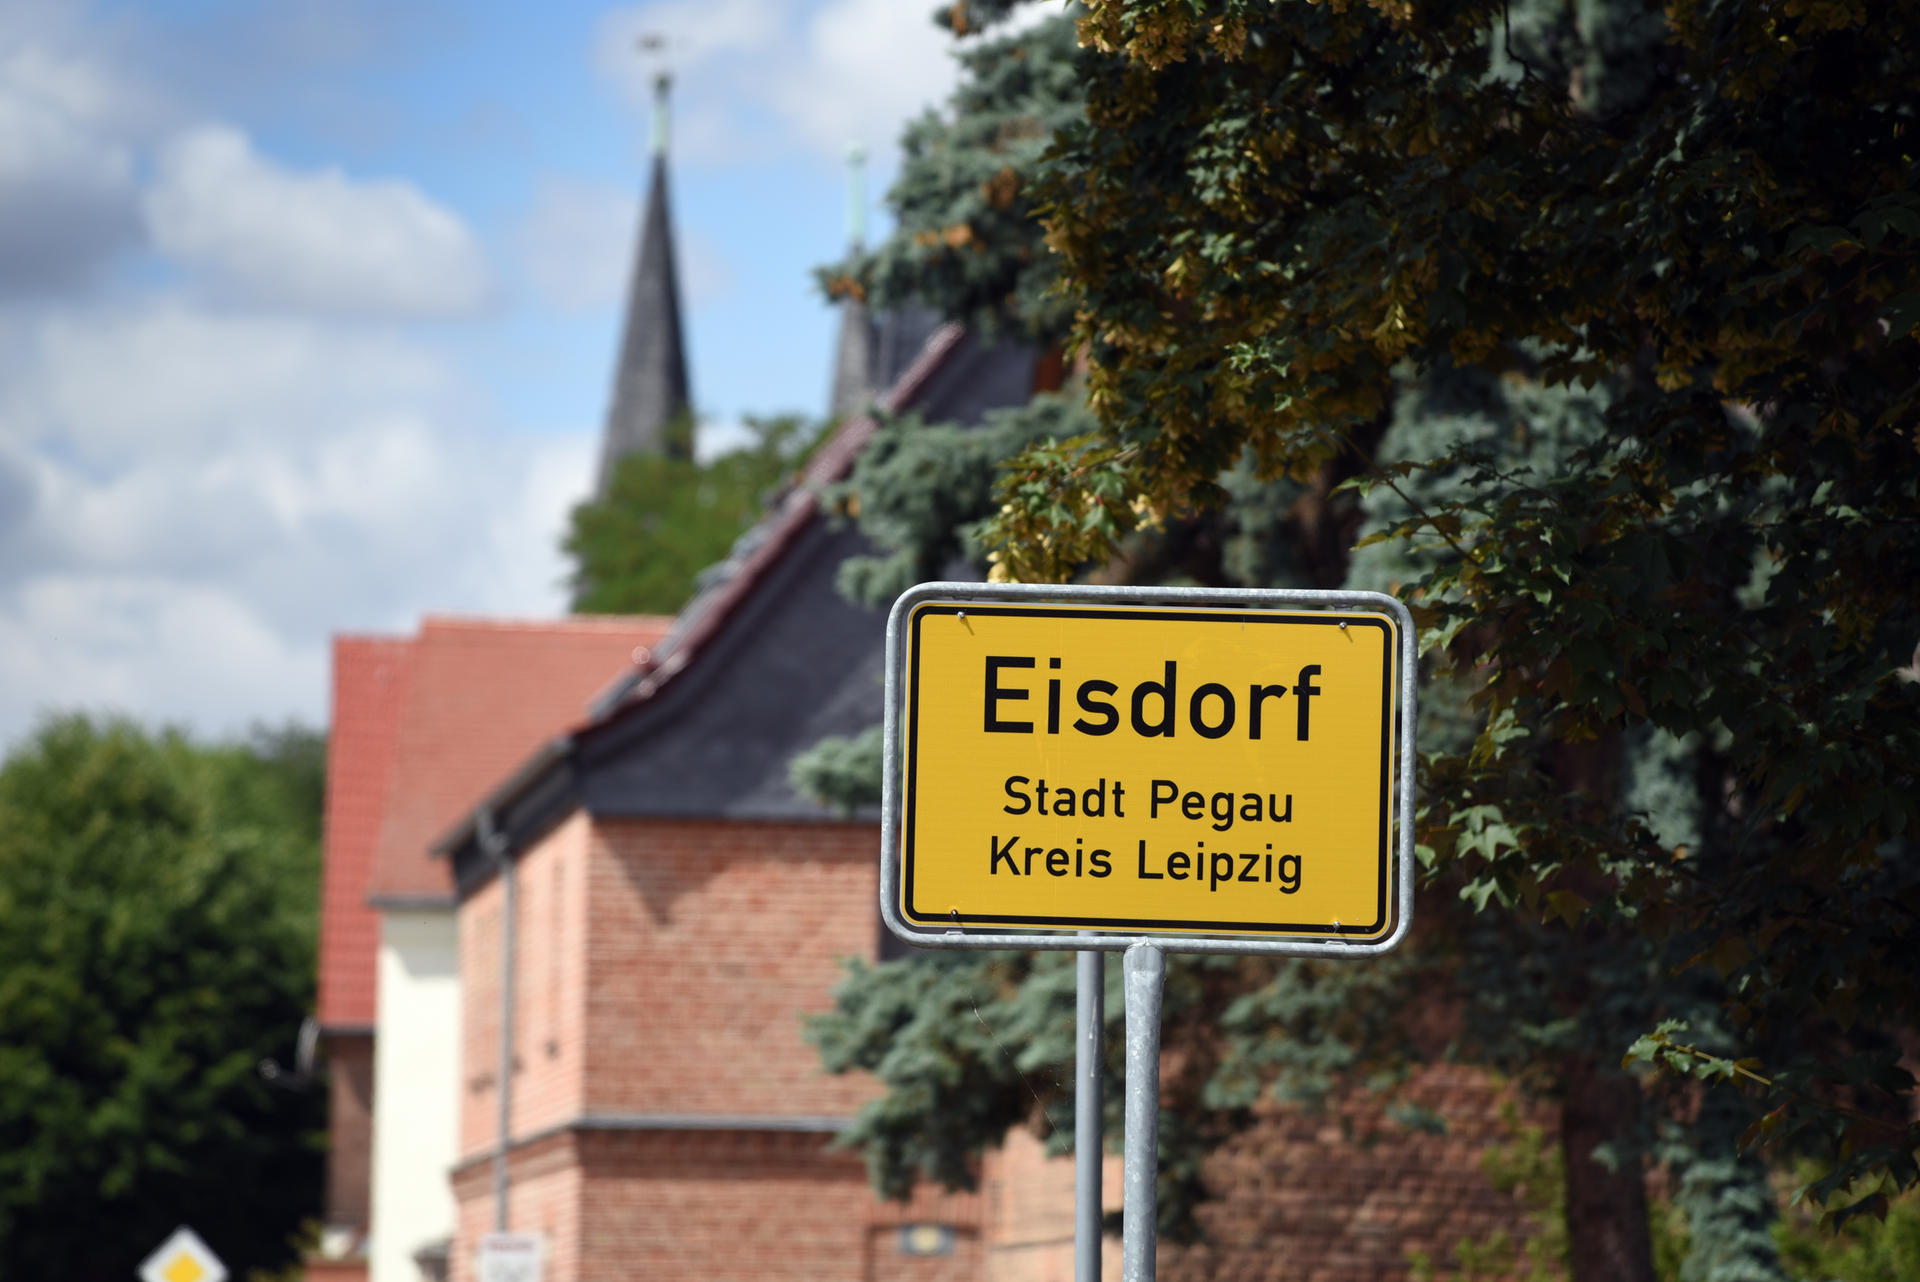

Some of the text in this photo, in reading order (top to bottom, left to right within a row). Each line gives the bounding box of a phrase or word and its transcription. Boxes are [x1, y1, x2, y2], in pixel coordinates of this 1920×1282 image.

[984, 655, 1321, 741] Eisdorf
[1003, 775, 1293, 832] Stadt Pegau
[990, 835, 1302, 894] Kreis Leipzig
